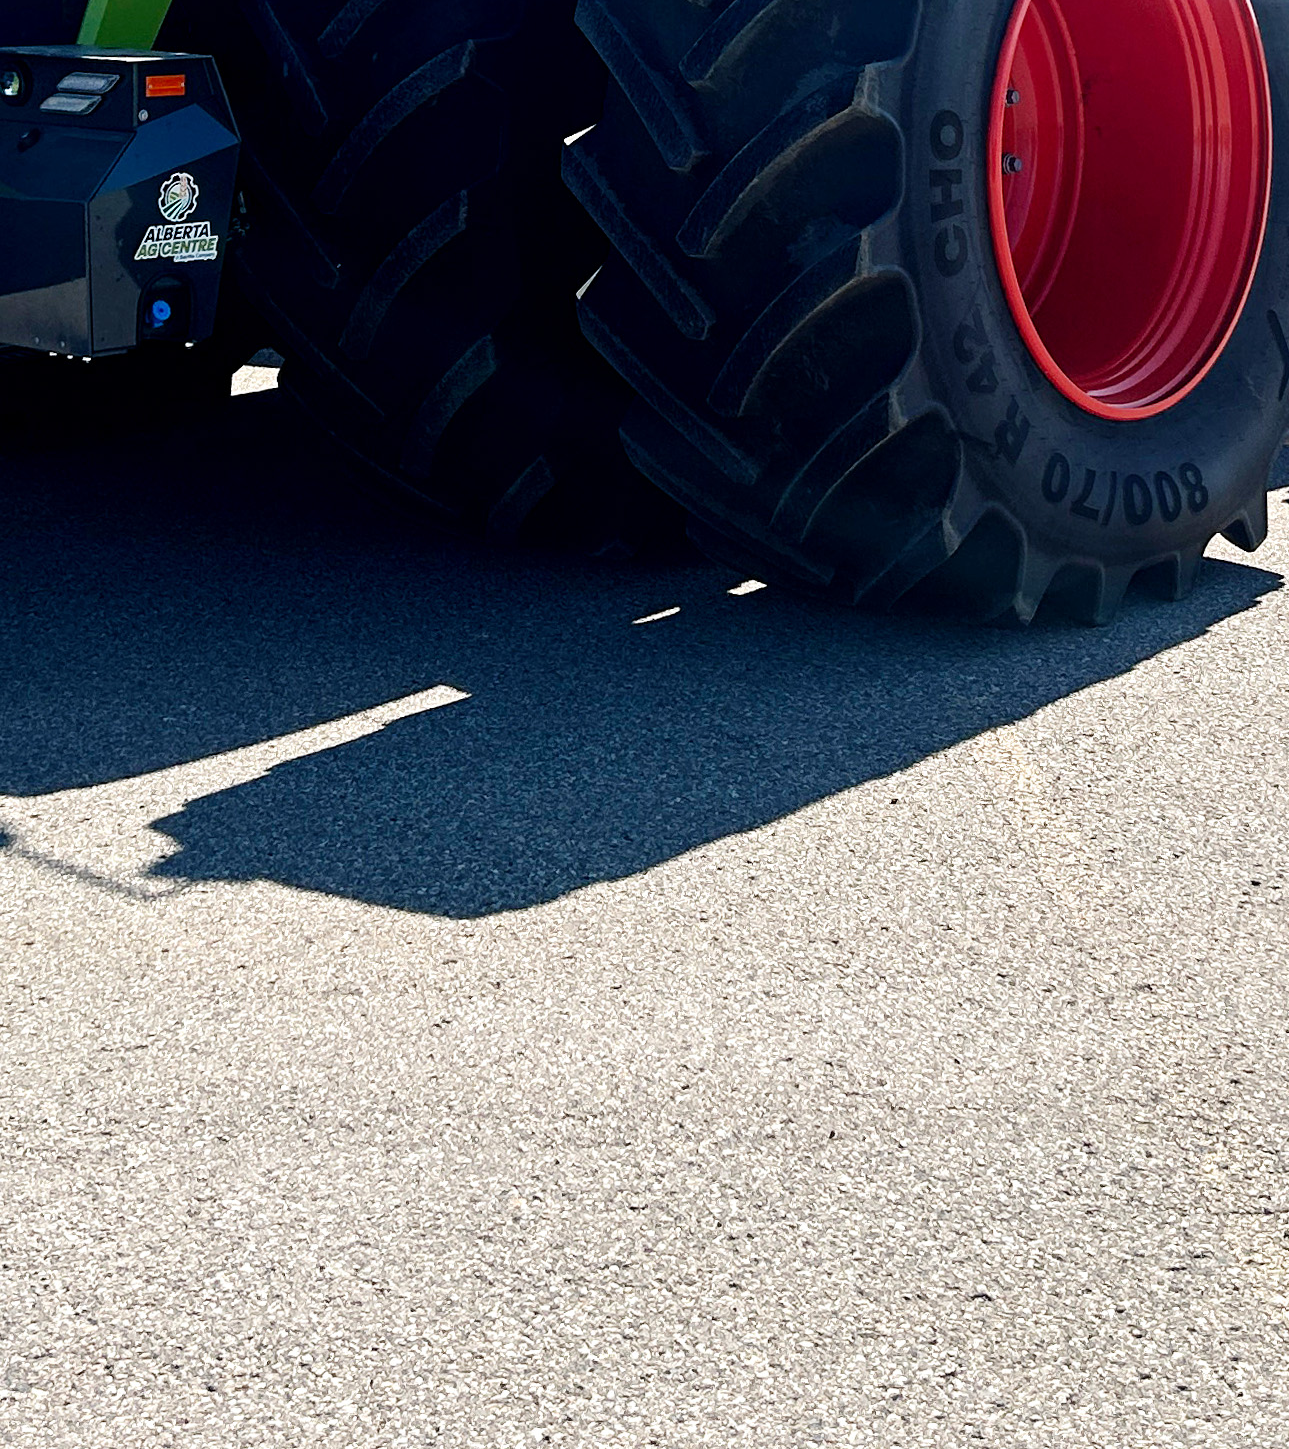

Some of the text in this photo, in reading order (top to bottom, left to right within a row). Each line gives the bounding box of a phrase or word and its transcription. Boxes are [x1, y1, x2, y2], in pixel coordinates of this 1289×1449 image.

[929, 109, 968, 279] CHO
[137, 243, 158, 257] AG
[162, 237, 217, 255] CENTRE
[144, 224, 209, 242] ALBERTA
[1041, 452, 1209, 526] 800/70
